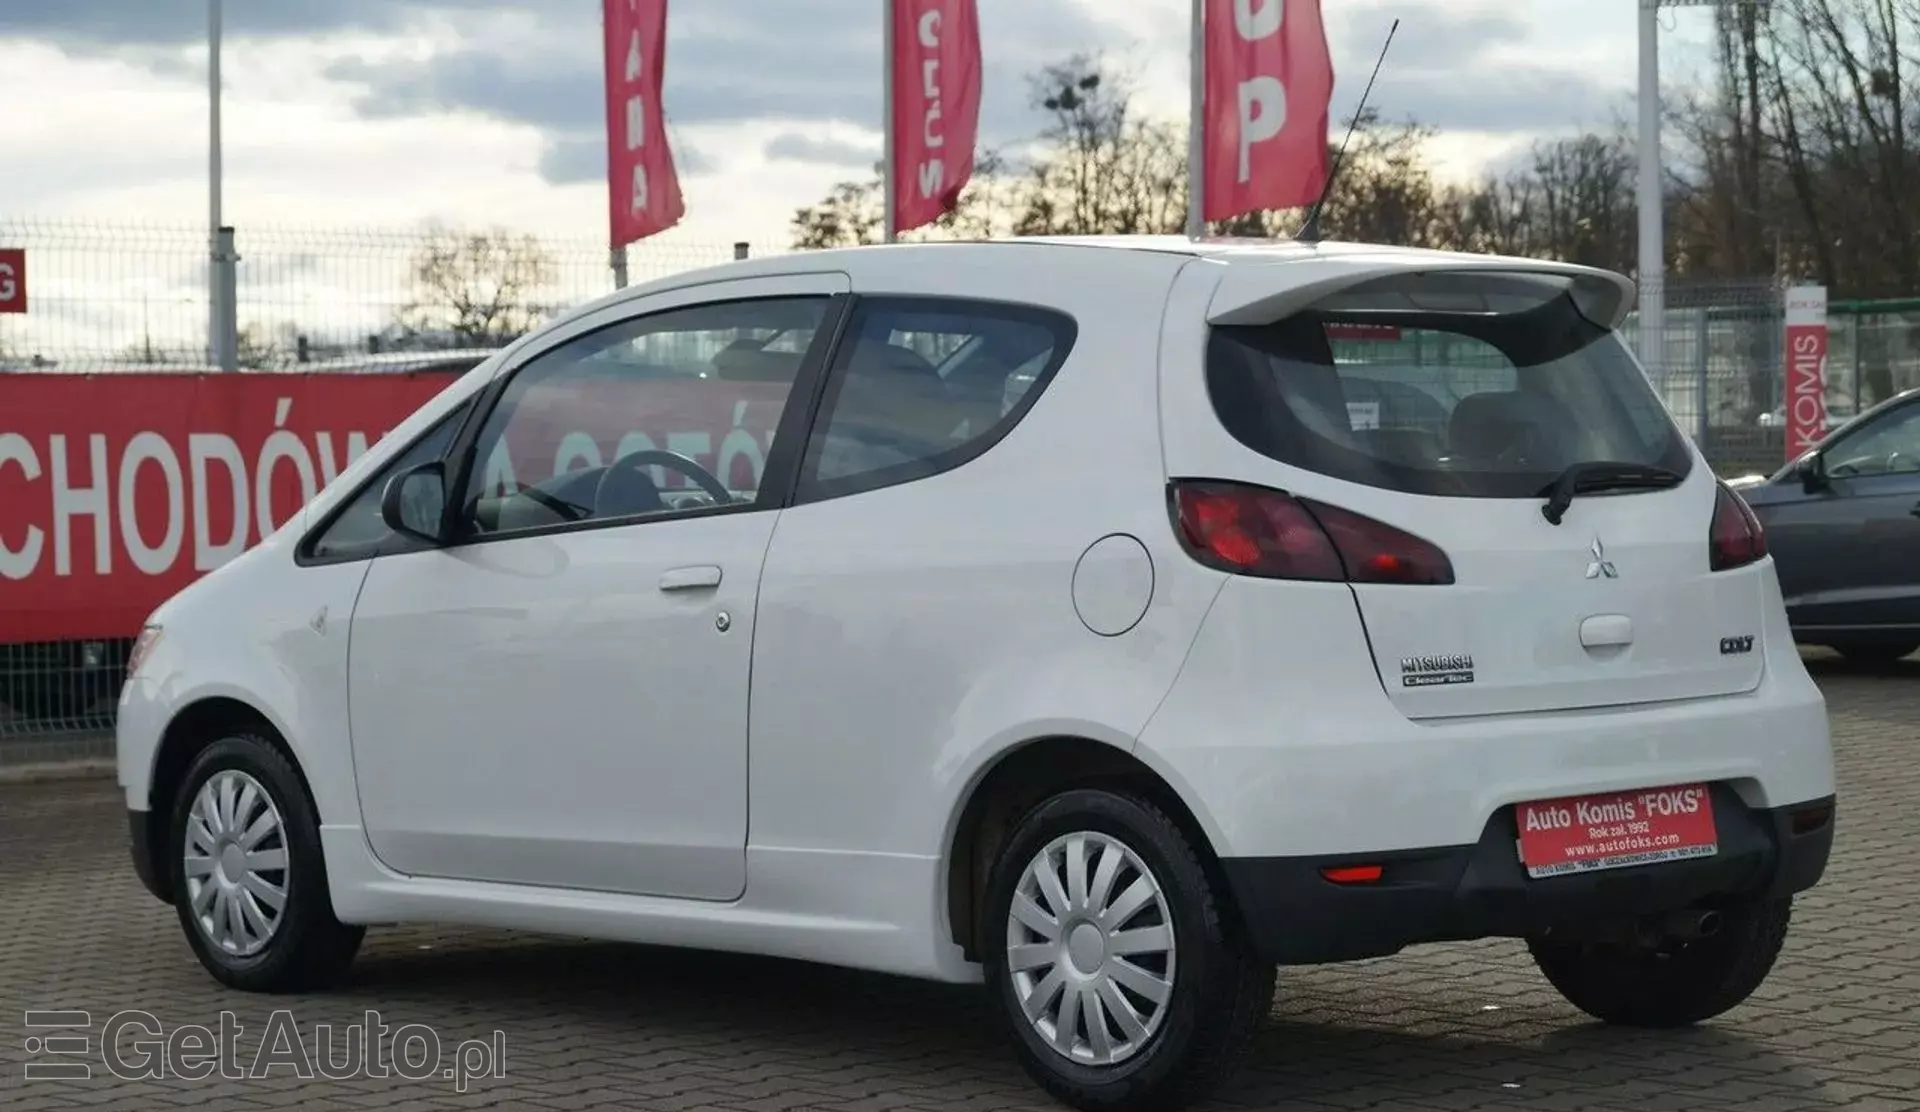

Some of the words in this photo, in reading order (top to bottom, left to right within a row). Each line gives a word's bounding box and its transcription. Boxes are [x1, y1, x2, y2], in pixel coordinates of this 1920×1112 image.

[1794, 334, 1819, 449] KOMIS
[0, 397, 388, 580] CHODÓ
[1400, 654, 1474, 673] MITSUBISHI
[1526, 807, 1571, 832] Auto
[1576, 798, 1635, 826] Komis
[1638, 788, 1703, 818] "FOKS"
[1565, 832, 1680, 858] www.autofoks.com
[1588, 826, 1610, 840] Rok
